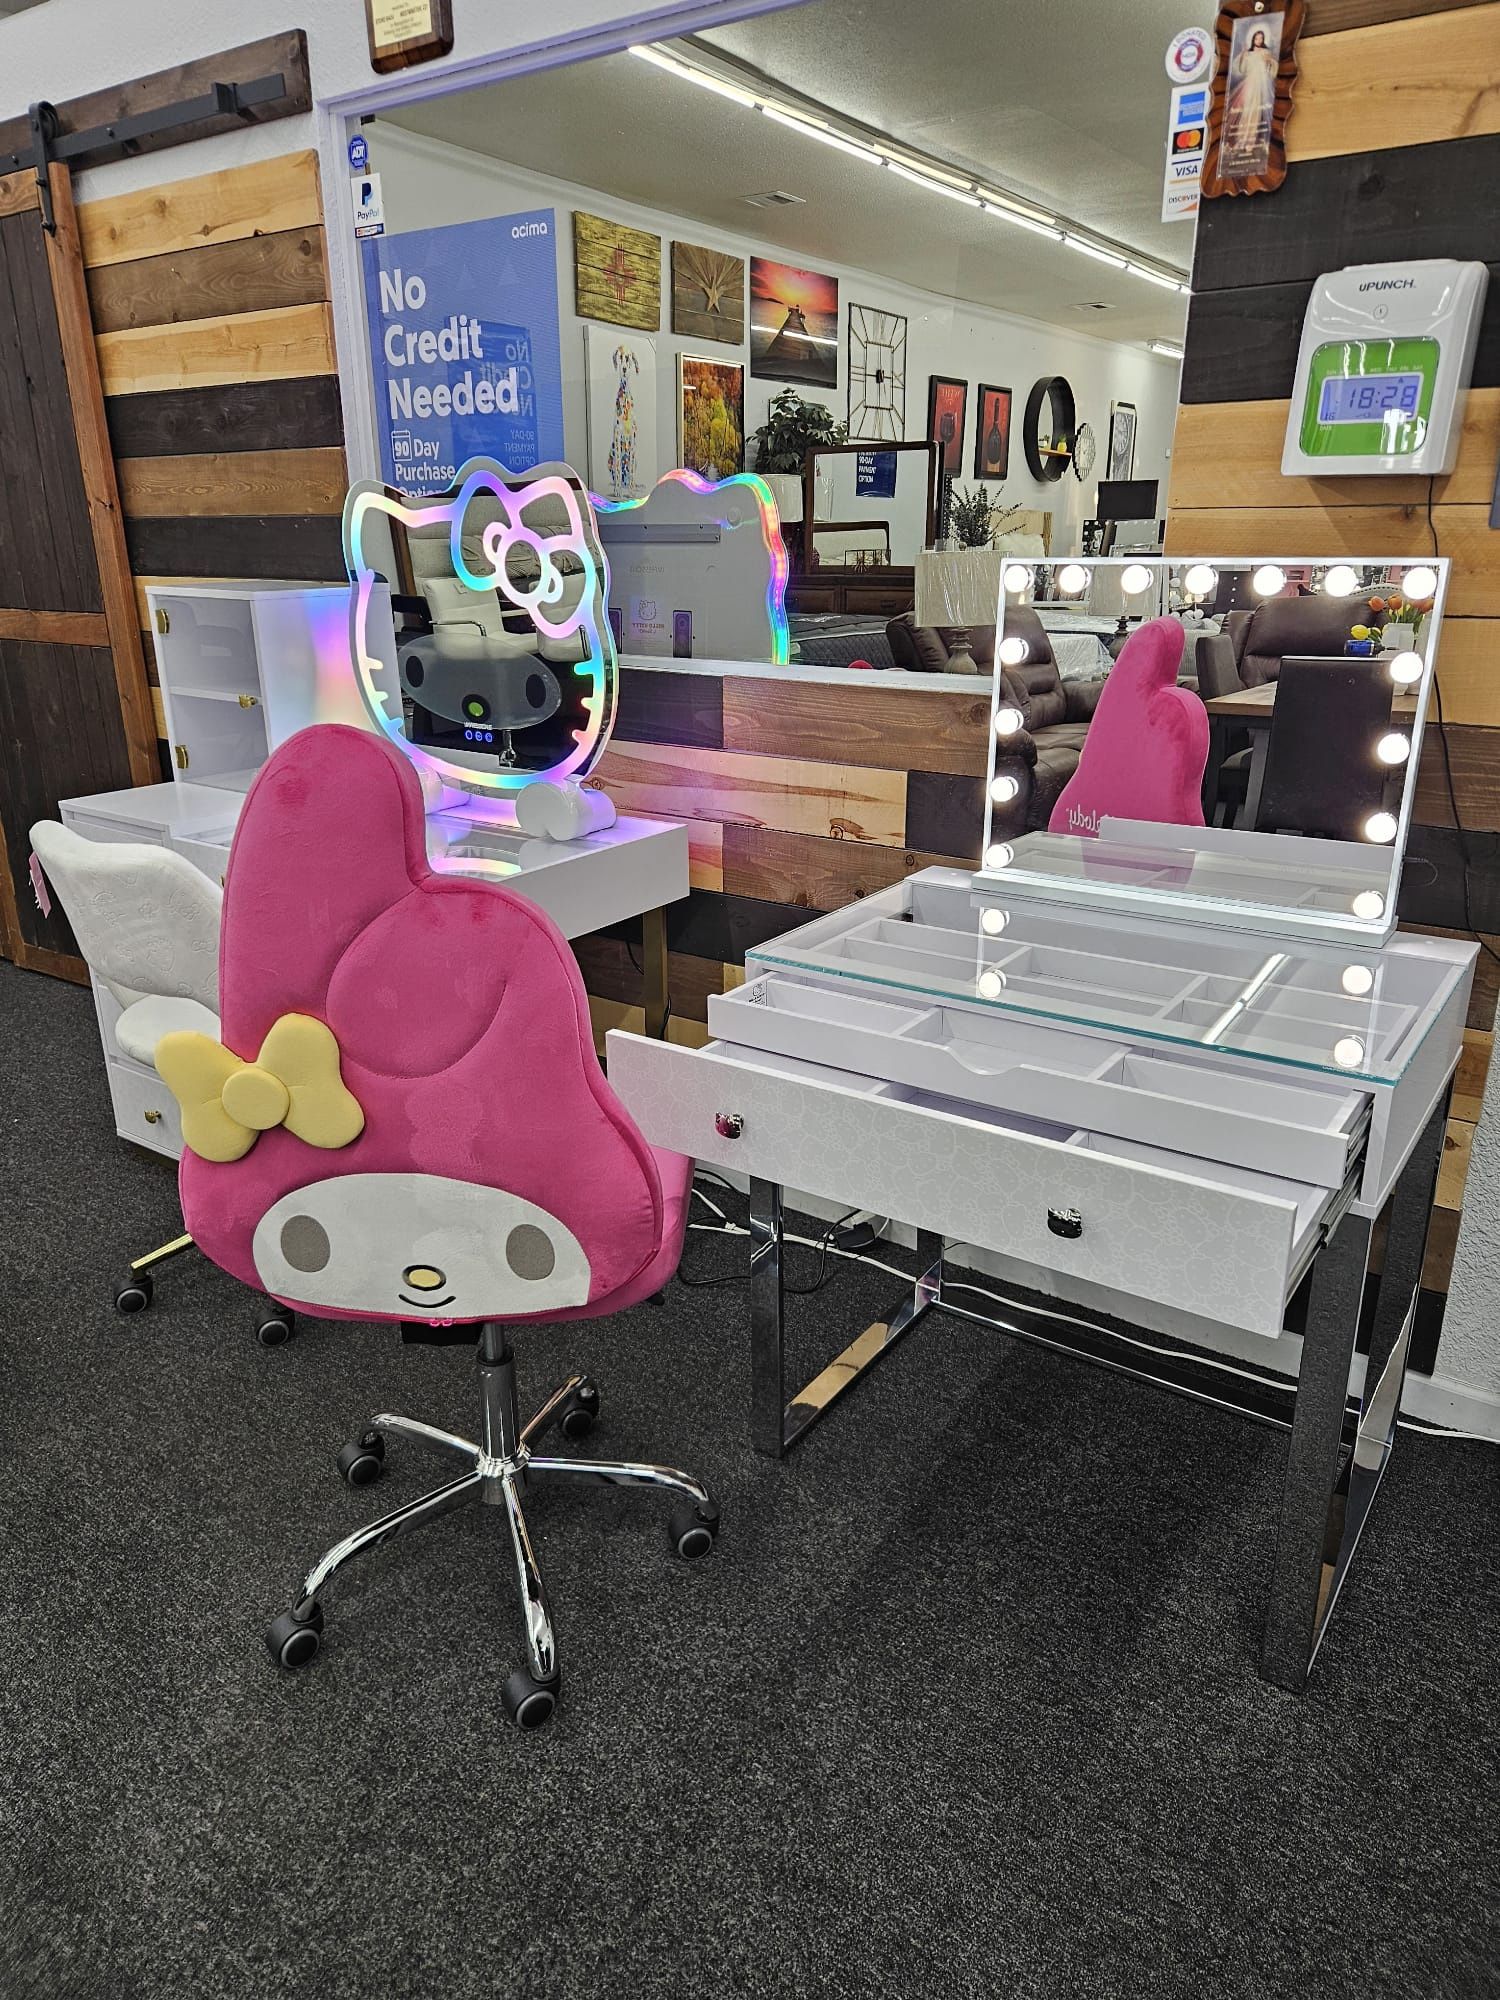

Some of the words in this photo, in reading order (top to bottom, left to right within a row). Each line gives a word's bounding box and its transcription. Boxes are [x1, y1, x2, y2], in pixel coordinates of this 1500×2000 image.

[352, 145, 365, 159] ADT
[1175, 165, 1199, 177] VISA
[1168, 193, 1198, 204] DISCOVER
[357, 209, 380, 221] PayPal
[511, 222, 548, 239] acima
[379, 268, 426, 314] No
[384, 314, 483, 367] Credit
[388, 367, 520, 420] Needed
[1349, 385, 1418, 409] 18:28
[394, 440, 410, 457] 90
[413, 438, 440, 460] Day
[395, 461, 456, 481] Purchase
